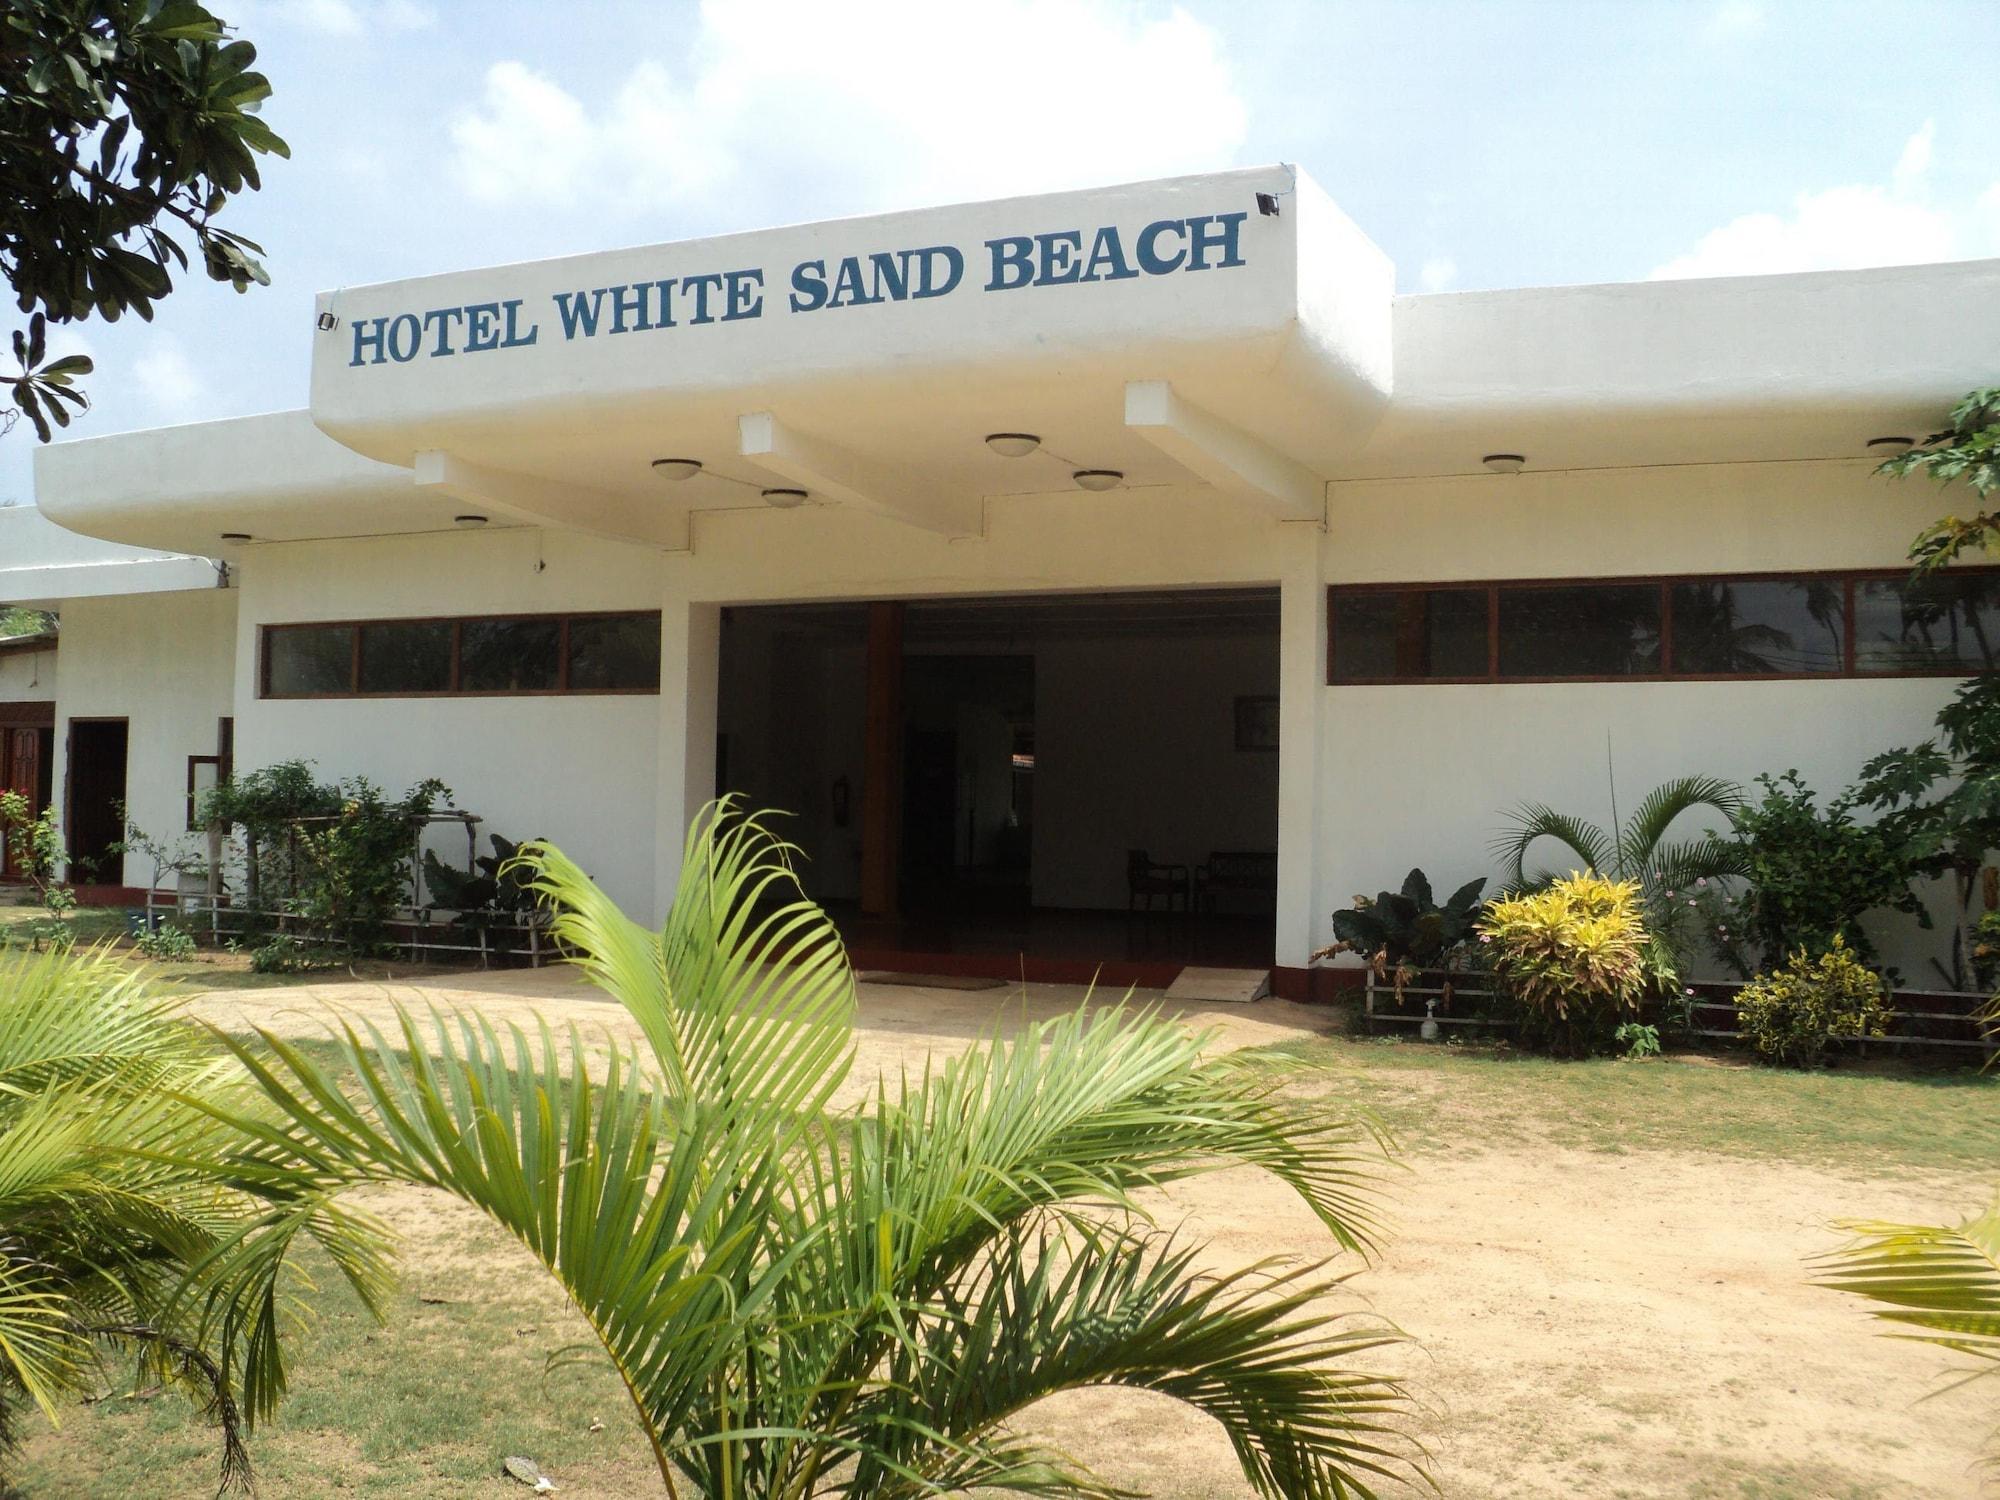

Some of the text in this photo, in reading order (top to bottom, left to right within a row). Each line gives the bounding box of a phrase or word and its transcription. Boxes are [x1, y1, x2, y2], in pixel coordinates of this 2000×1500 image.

[348, 211, 1248, 368] HOTEL WHITE SAND BEACH
